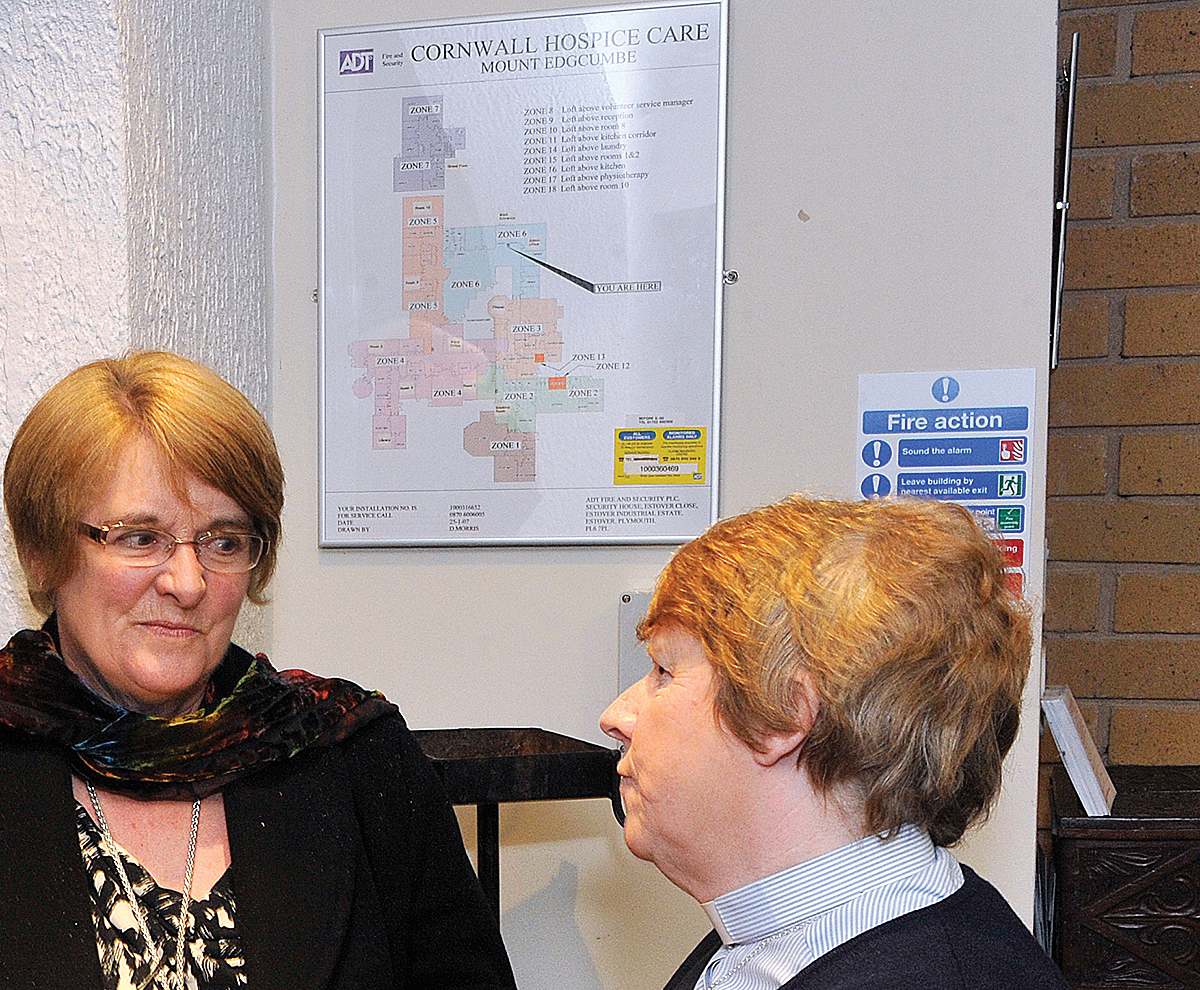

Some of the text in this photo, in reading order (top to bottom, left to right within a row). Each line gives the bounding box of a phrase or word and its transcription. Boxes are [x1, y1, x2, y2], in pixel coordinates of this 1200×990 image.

[411, 23, 710, 62] CORNWALL HOSPICE CARE
[340, 51, 372, 72] ADT
[481, 51, 637, 74] MOUNT EDGCUMBE
[410, 106, 433, 114] ZONE
[524, 107, 547, 116] ZONE
[562, 105, 577, 113] Loft
[663, 99, 693, 107] manager
[524, 118, 547, 126] ZONE
[600, 112, 633, 121] reception
[524, 128, 547, 136] ZONE
[562, 125, 576, 133] Loft
[578, 124, 599, 132] above
[524, 130, 657, 146] ZONE 11 Loft above kitchen corridor
[524, 147, 547, 155] ZONE
[549, 146, 557, 154] 14
[561, 145, 576, 153] Loft
[578, 144, 599, 152] above
[524, 157, 547, 165] ZONE
[549, 156, 557, 164] 15
[561, 155, 576, 163] Loft
[625, 151, 640, 159] 1&2
[401, 162, 423, 170] ZONE
[523, 166, 547, 175] ZONE
[561, 165, 576, 173] Loft
[600, 162, 626, 170] kitchen
[523, 176, 546, 185] ZONE
[561, 175, 576, 183] Loft
[600, 171, 649, 181] physiotherapy
[523, 186, 546, 195] ZONE
[561, 184, 576, 192] Loft
[409, 218, 432, 226] ZONE
[451, 281, 474, 289] ZONE
[596, 282, 660, 293] YOU ARE HERE
[887, 412, 1002, 431] Fire action
[931, 447, 946, 455] the
[928, 478, 961, 487] building
[963, 477, 974, 486] by
[933, 487, 970, 495] available
